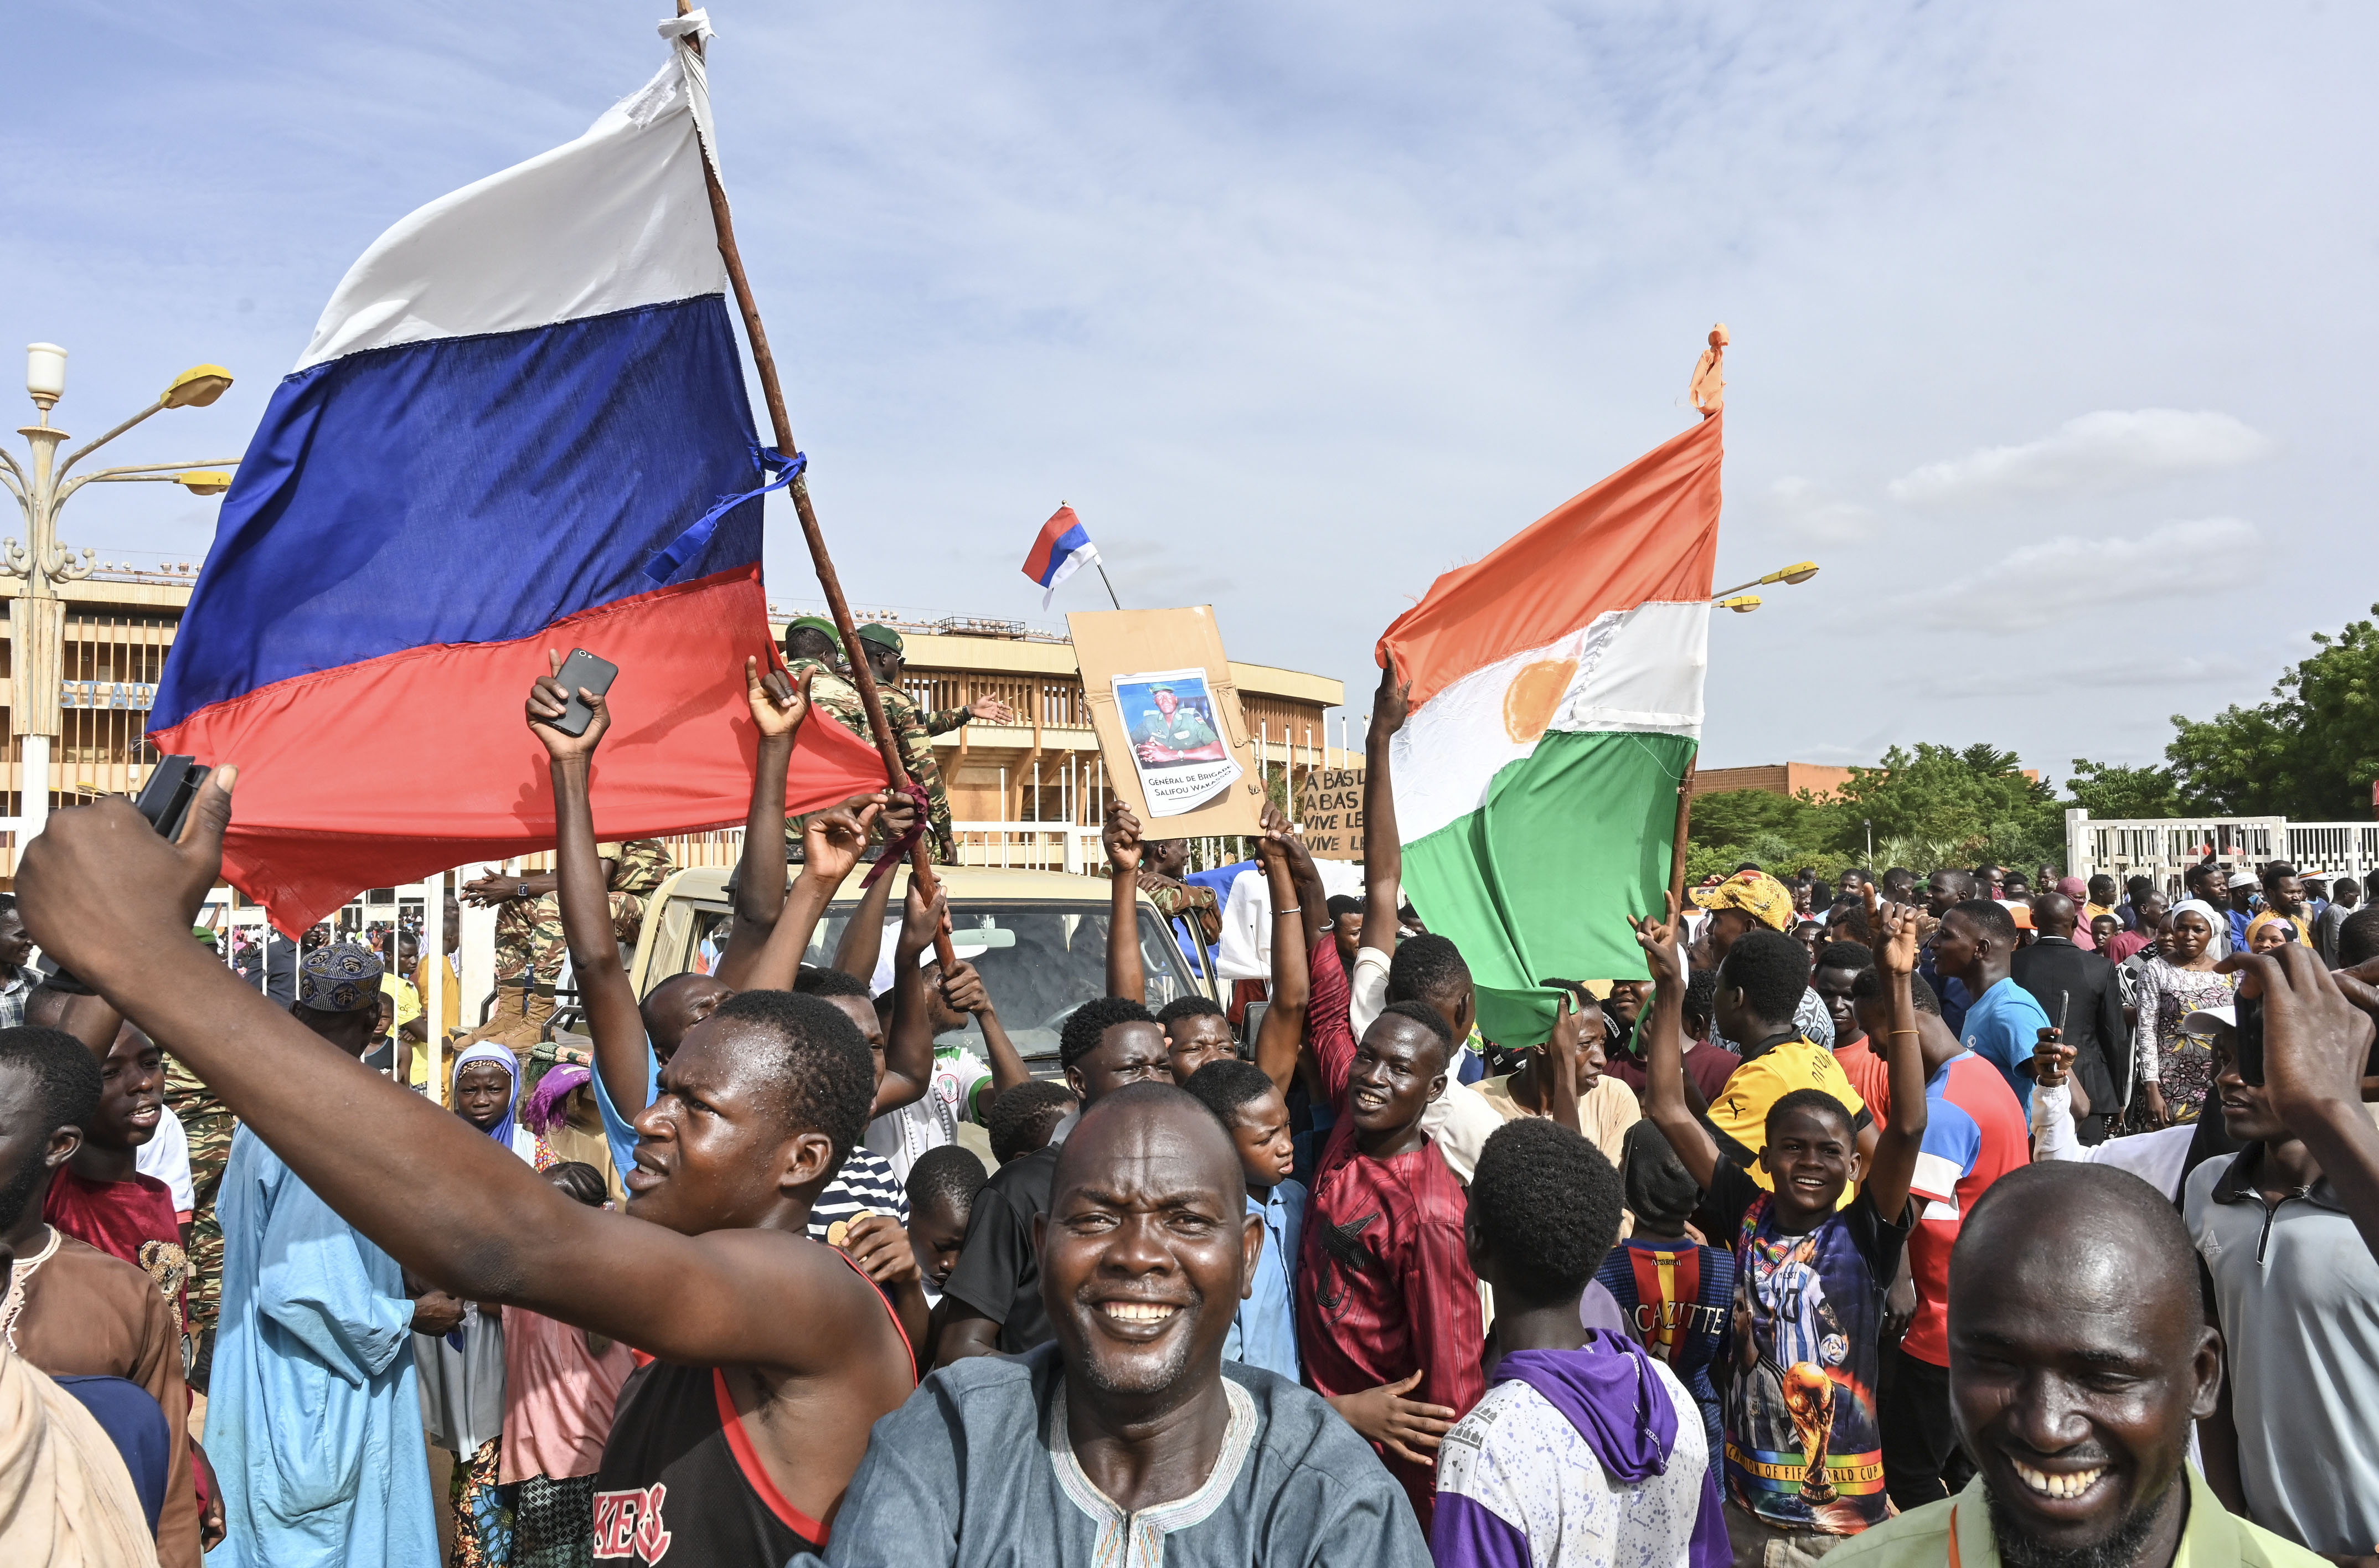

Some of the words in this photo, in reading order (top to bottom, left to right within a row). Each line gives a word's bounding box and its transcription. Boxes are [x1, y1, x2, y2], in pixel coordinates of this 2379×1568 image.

[1148, 776, 1184, 786] GÉNÉRAL
[1198, 765, 1232, 781] BRIGADE
[1154, 787, 1189, 796] SALIFOU
[1190, 770, 1232, 791] WAKASSO
[1305, 773, 1319, 792] A
[1324, 770, 1354, 790] BAS
[1304, 793, 1317, 811] A
[1319, 791, 1359, 811] BAS
[1346, 811, 1364, 829] LE
[1778, 1271, 1797, 1280] MESSI
[1766, 1465, 1777, 1477] OF
[1860, 1466, 1878, 1480] CUP
